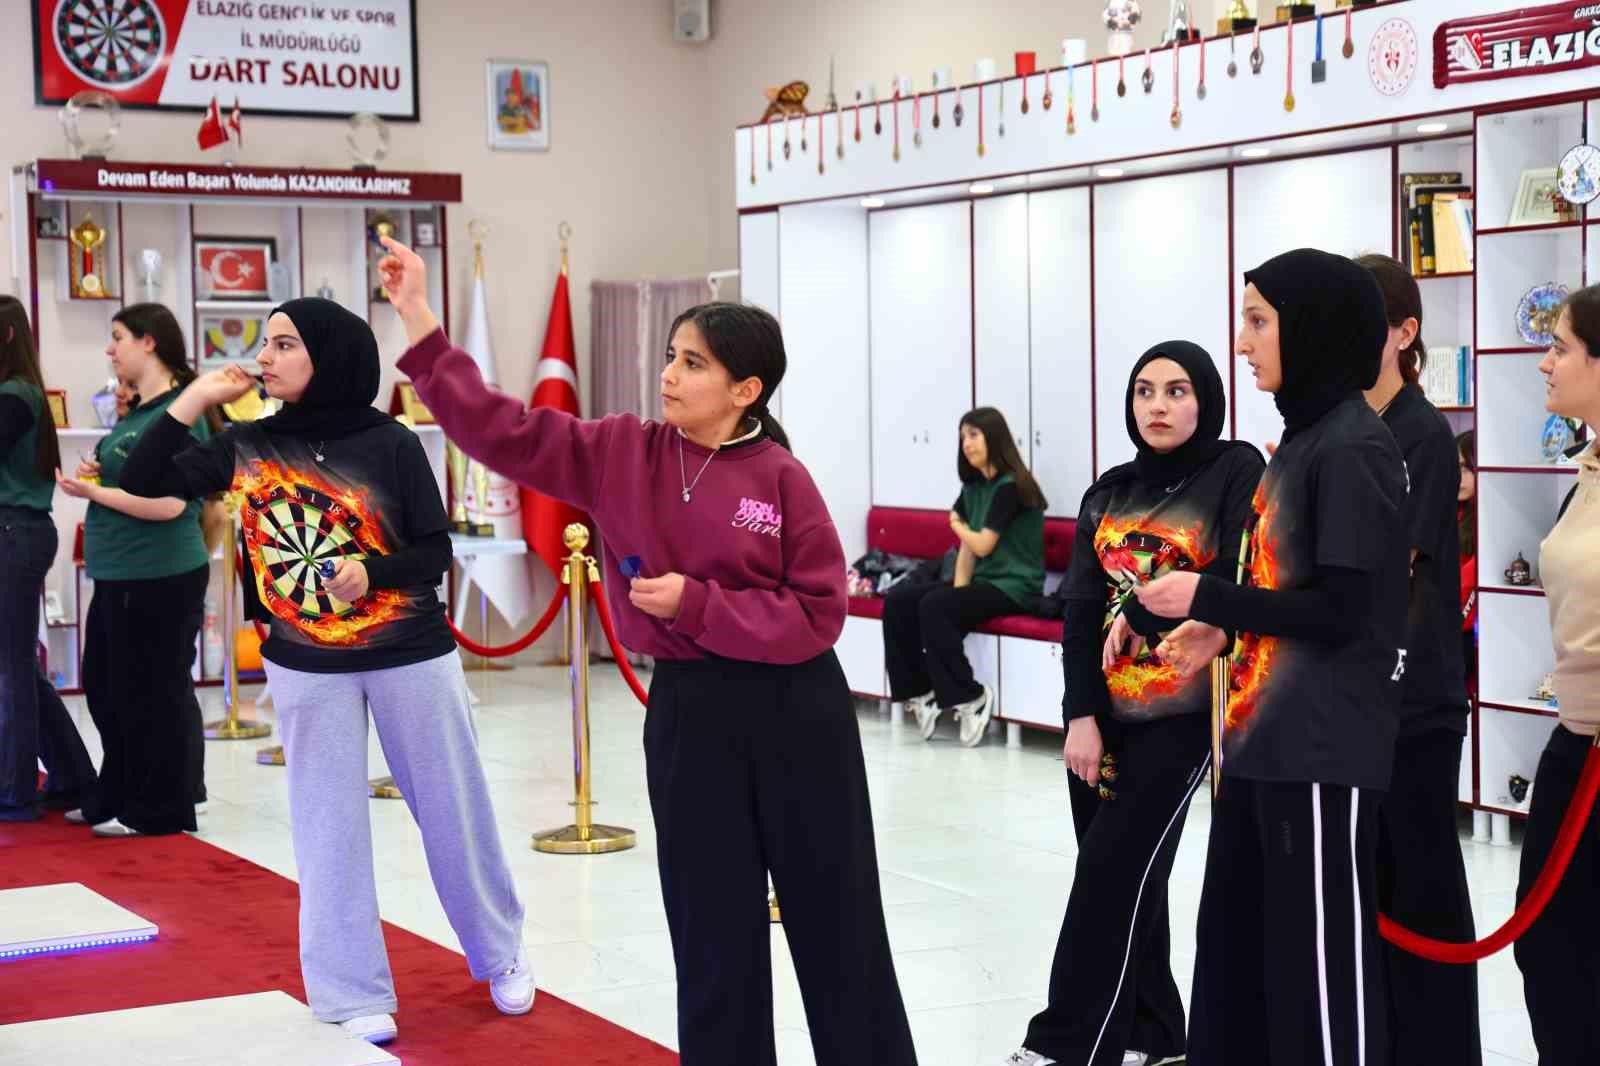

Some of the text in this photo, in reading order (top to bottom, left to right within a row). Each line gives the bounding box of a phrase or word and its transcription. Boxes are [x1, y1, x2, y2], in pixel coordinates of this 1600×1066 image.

[190, 56, 400, 90] DART SALONU
[98, 168, 147, 187] Devam
[150, 170, 185, 188] Eden
[232, 173, 287, 191] Yolunda
[289, 174, 411, 194] KAZANDIKLARIMIZ
